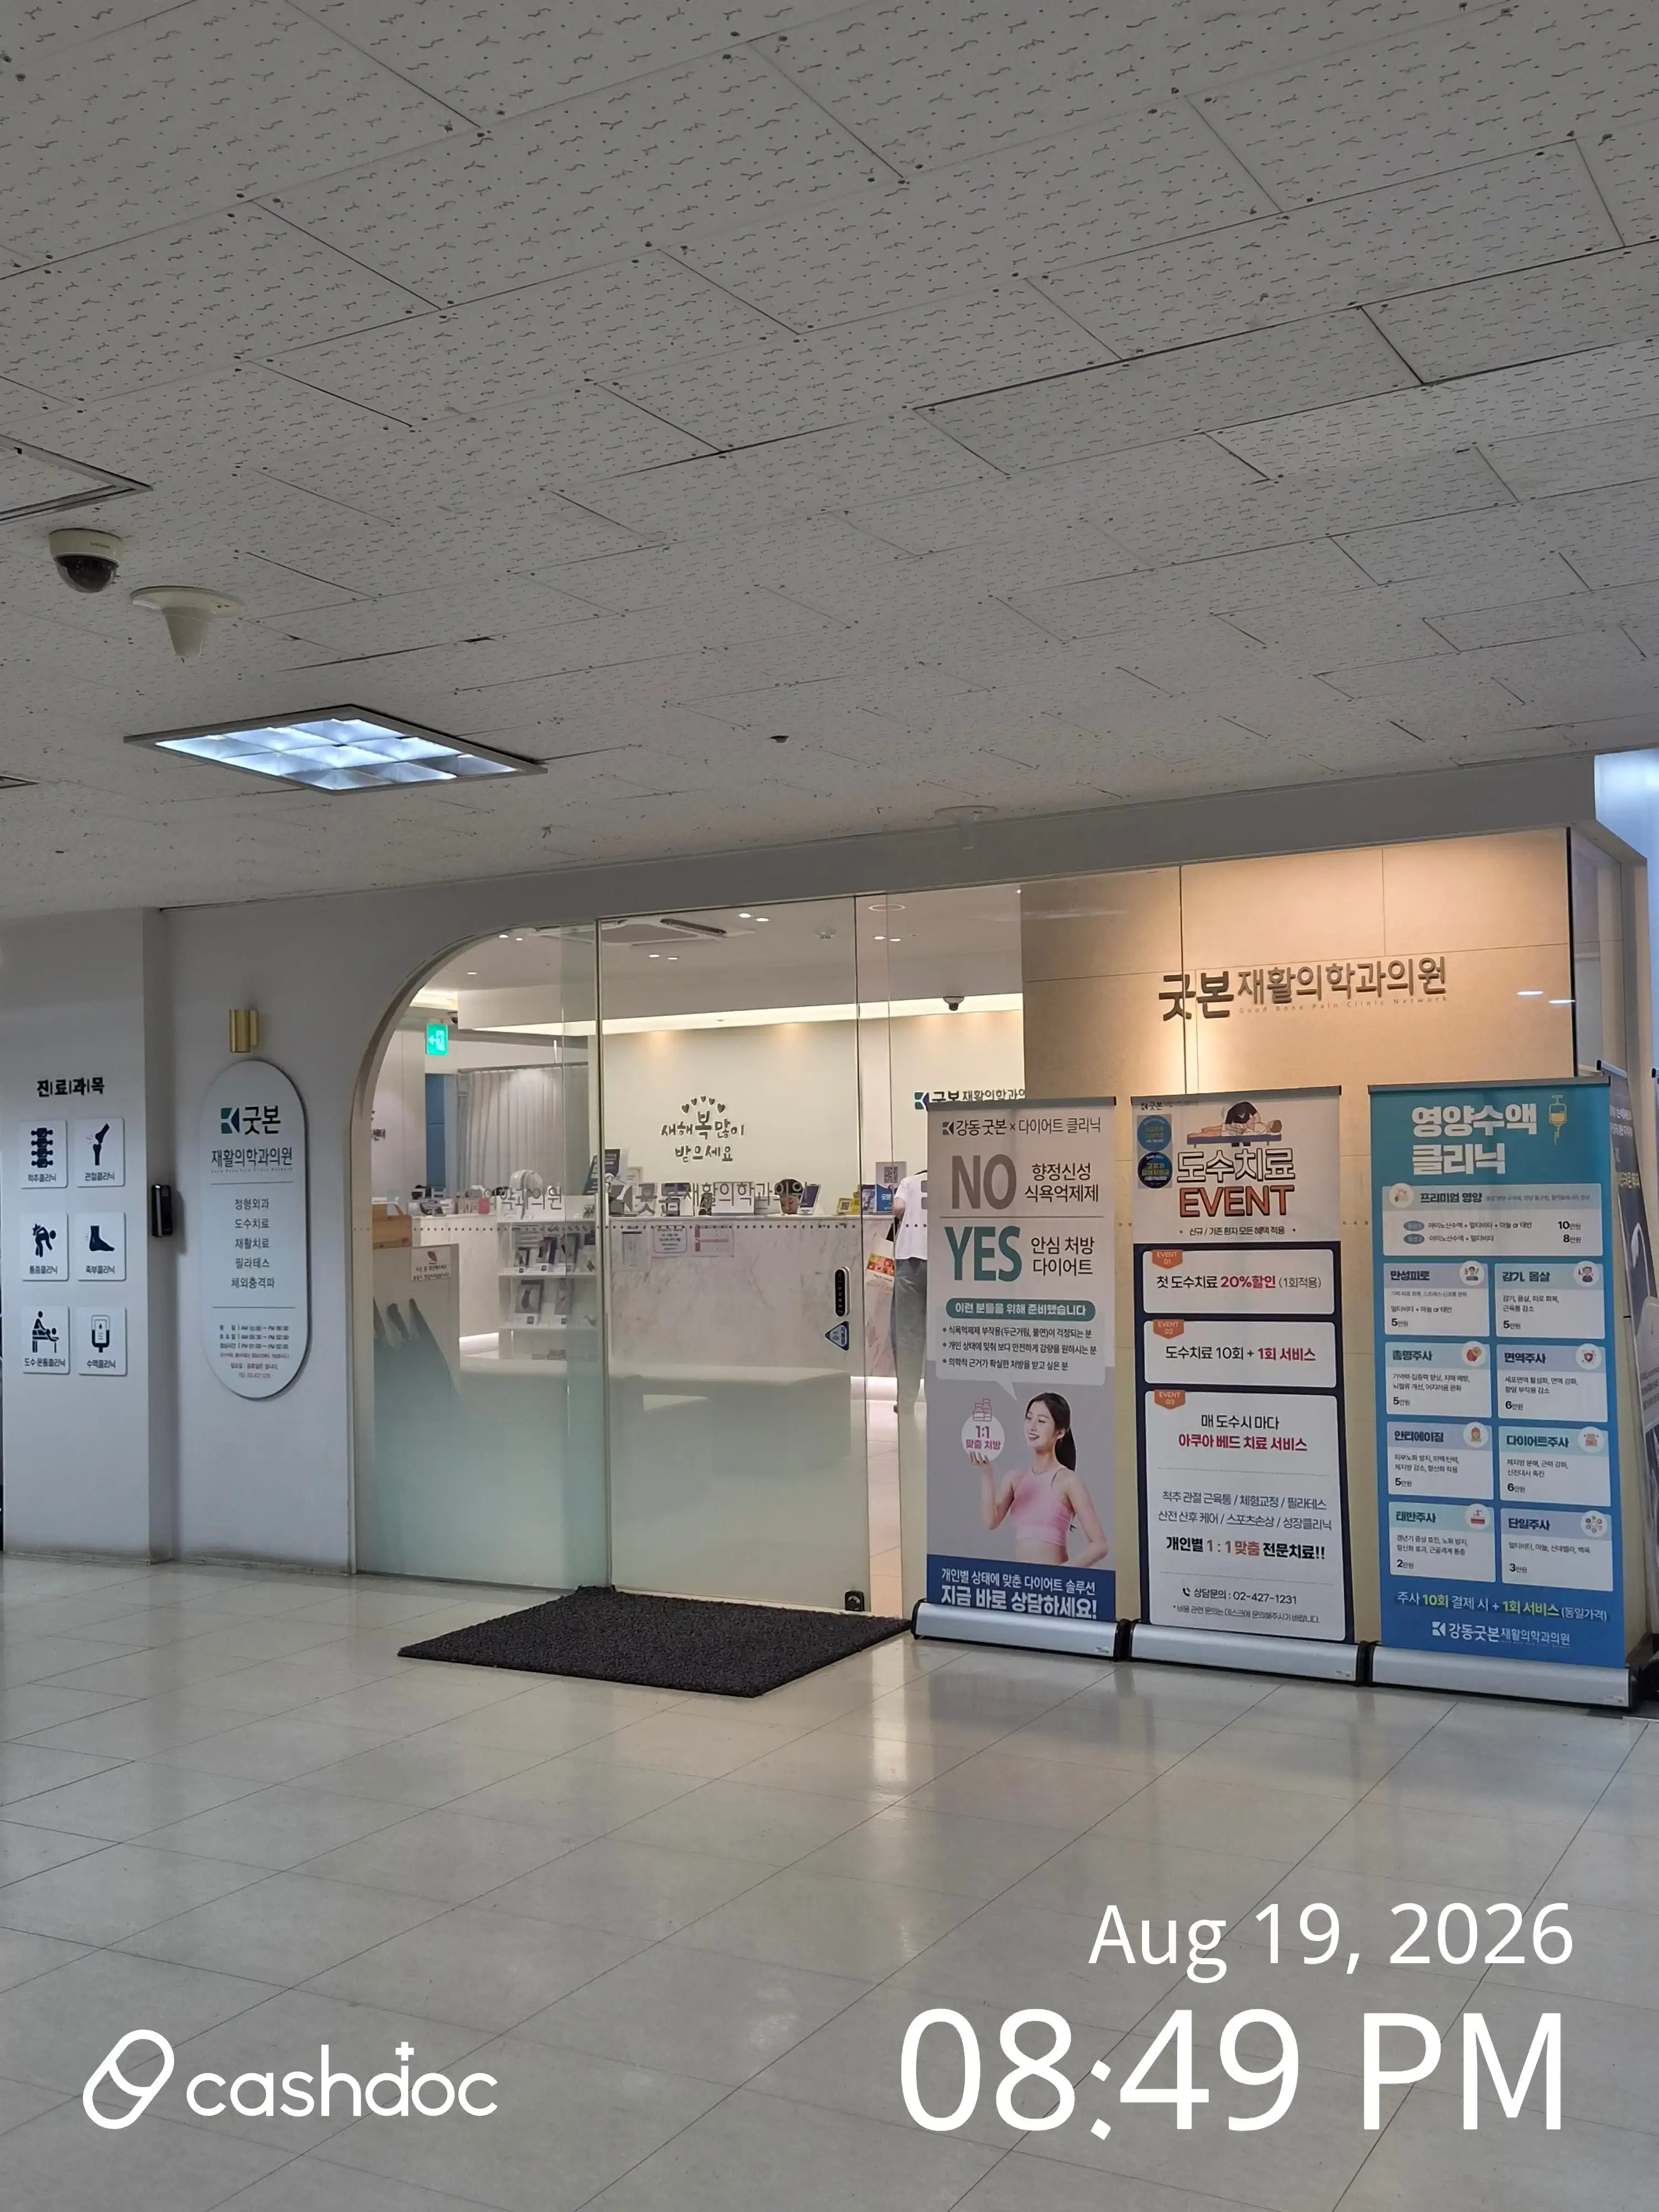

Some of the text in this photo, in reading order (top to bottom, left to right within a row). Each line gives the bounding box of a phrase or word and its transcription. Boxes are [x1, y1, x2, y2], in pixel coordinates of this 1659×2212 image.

[1238, 956, 1447, 1005] 재활의학과의원
[1394, 996, 1447, 1005] Network
[243, 1105, 281, 1135] 굿본
[661, 1111, 744, 1140] 새해 복 많이
[1019, 1118, 1063, 1134] 다이어트
[1066, 1117, 1101, 1133] 클리닉
[1412, 1104, 1537, 1138] 영양수액
[211, 1147, 292, 1167] 재활의학과의원
[675, 1145, 733, 1162] 받으세요
[1412, 1142, 1506, 1175] 클리닉
[1031, 1162, 1091, 1181] 향정신성
[1177, 1147, 1296, 1183] 도수치료
[952, 1154, 1017, 1210] NO
[1025, 1184, 1098, 1203] 식욕억제제
[1179, 1185, 1295, 1218] EVENT
[1420, 1193, 1459, 1203] 프리미엄
[1462, 1192, 1482, 1203] 영양
[234, 1198, 269, 1210] 정형외과
[234, 1218, 270, 1229] 도수치료
[235, 1238, 270, 1249] 재활치료
[1031, 1237, 1095, 1255] 안심 처방
[945, 1225, 1022, 1282] YES
[236, 1258, 270, 1269] 필라테스
[1033, 1258, 1093, 1276] 다이어트
[231, 1277, 275, 1288] 체외충격파
[1157, 1275, 1321, 1290] 첫 도수치료 20%할인 (1회적용)
[1390, 1271, 1430, 1281] 만성피로
[1529, 1271, 1550, 1282] 몸살
[955, 1302, 974, 1314] 이런
[1006, 1303, 1025, 1314] 위해
[1027, 1304, 1086, 1316] 준비했습니다
[948, 1341, 961, 1350] 개인
[1166, 1346, 1316, 1361] 도수치료 10회 1회 서비스
[1392, 1350, 1432, 1361] 총명주사
[1504, 1353, 1546, 1364] 면역주사
[1201, 1415, 1280, 1430] 매 도수시 마다
[975, 1426, 989, 1439] 1:1
[1394, 1431, 1444, 1442] 안티에이징
[984, 1440, 1001, 1450] 처방
[1178, 1433, 1308, 1452] 아쿠아 베드 치료 서비스
[1506, 1435, 1569, 1448] 다이어트주사
[1162, 1491, 1181, 1502] 척추
[1287, 1497, 1327, 1510] 필라테스
[1158, 1510, 1177, 1522] 산전
[1396, 1511, 1436, 1523] 태반주사
[1508, 1517, 1550, 1531] 단일주사
[1166, 1536, 1326, 1560] 개인별 맞춤 전문치료!!
[941, 1568, 969, 1583] 개인별
[972, 1571, 1000, 1587] 상태에
[1024, 1575, 1063, 1592] 다이어트
[1066, 1579, 1095, 1596] 솔루션
[941, 1585, 1097, 1620] 지금 바로 상담하세요!
[1194, 1587, 1297, 1604] 상담문의 02-427-1231
[1397, 1591, 1608, 1622] 주사 10회 결제 시 1회 서비스 (동일가격)
